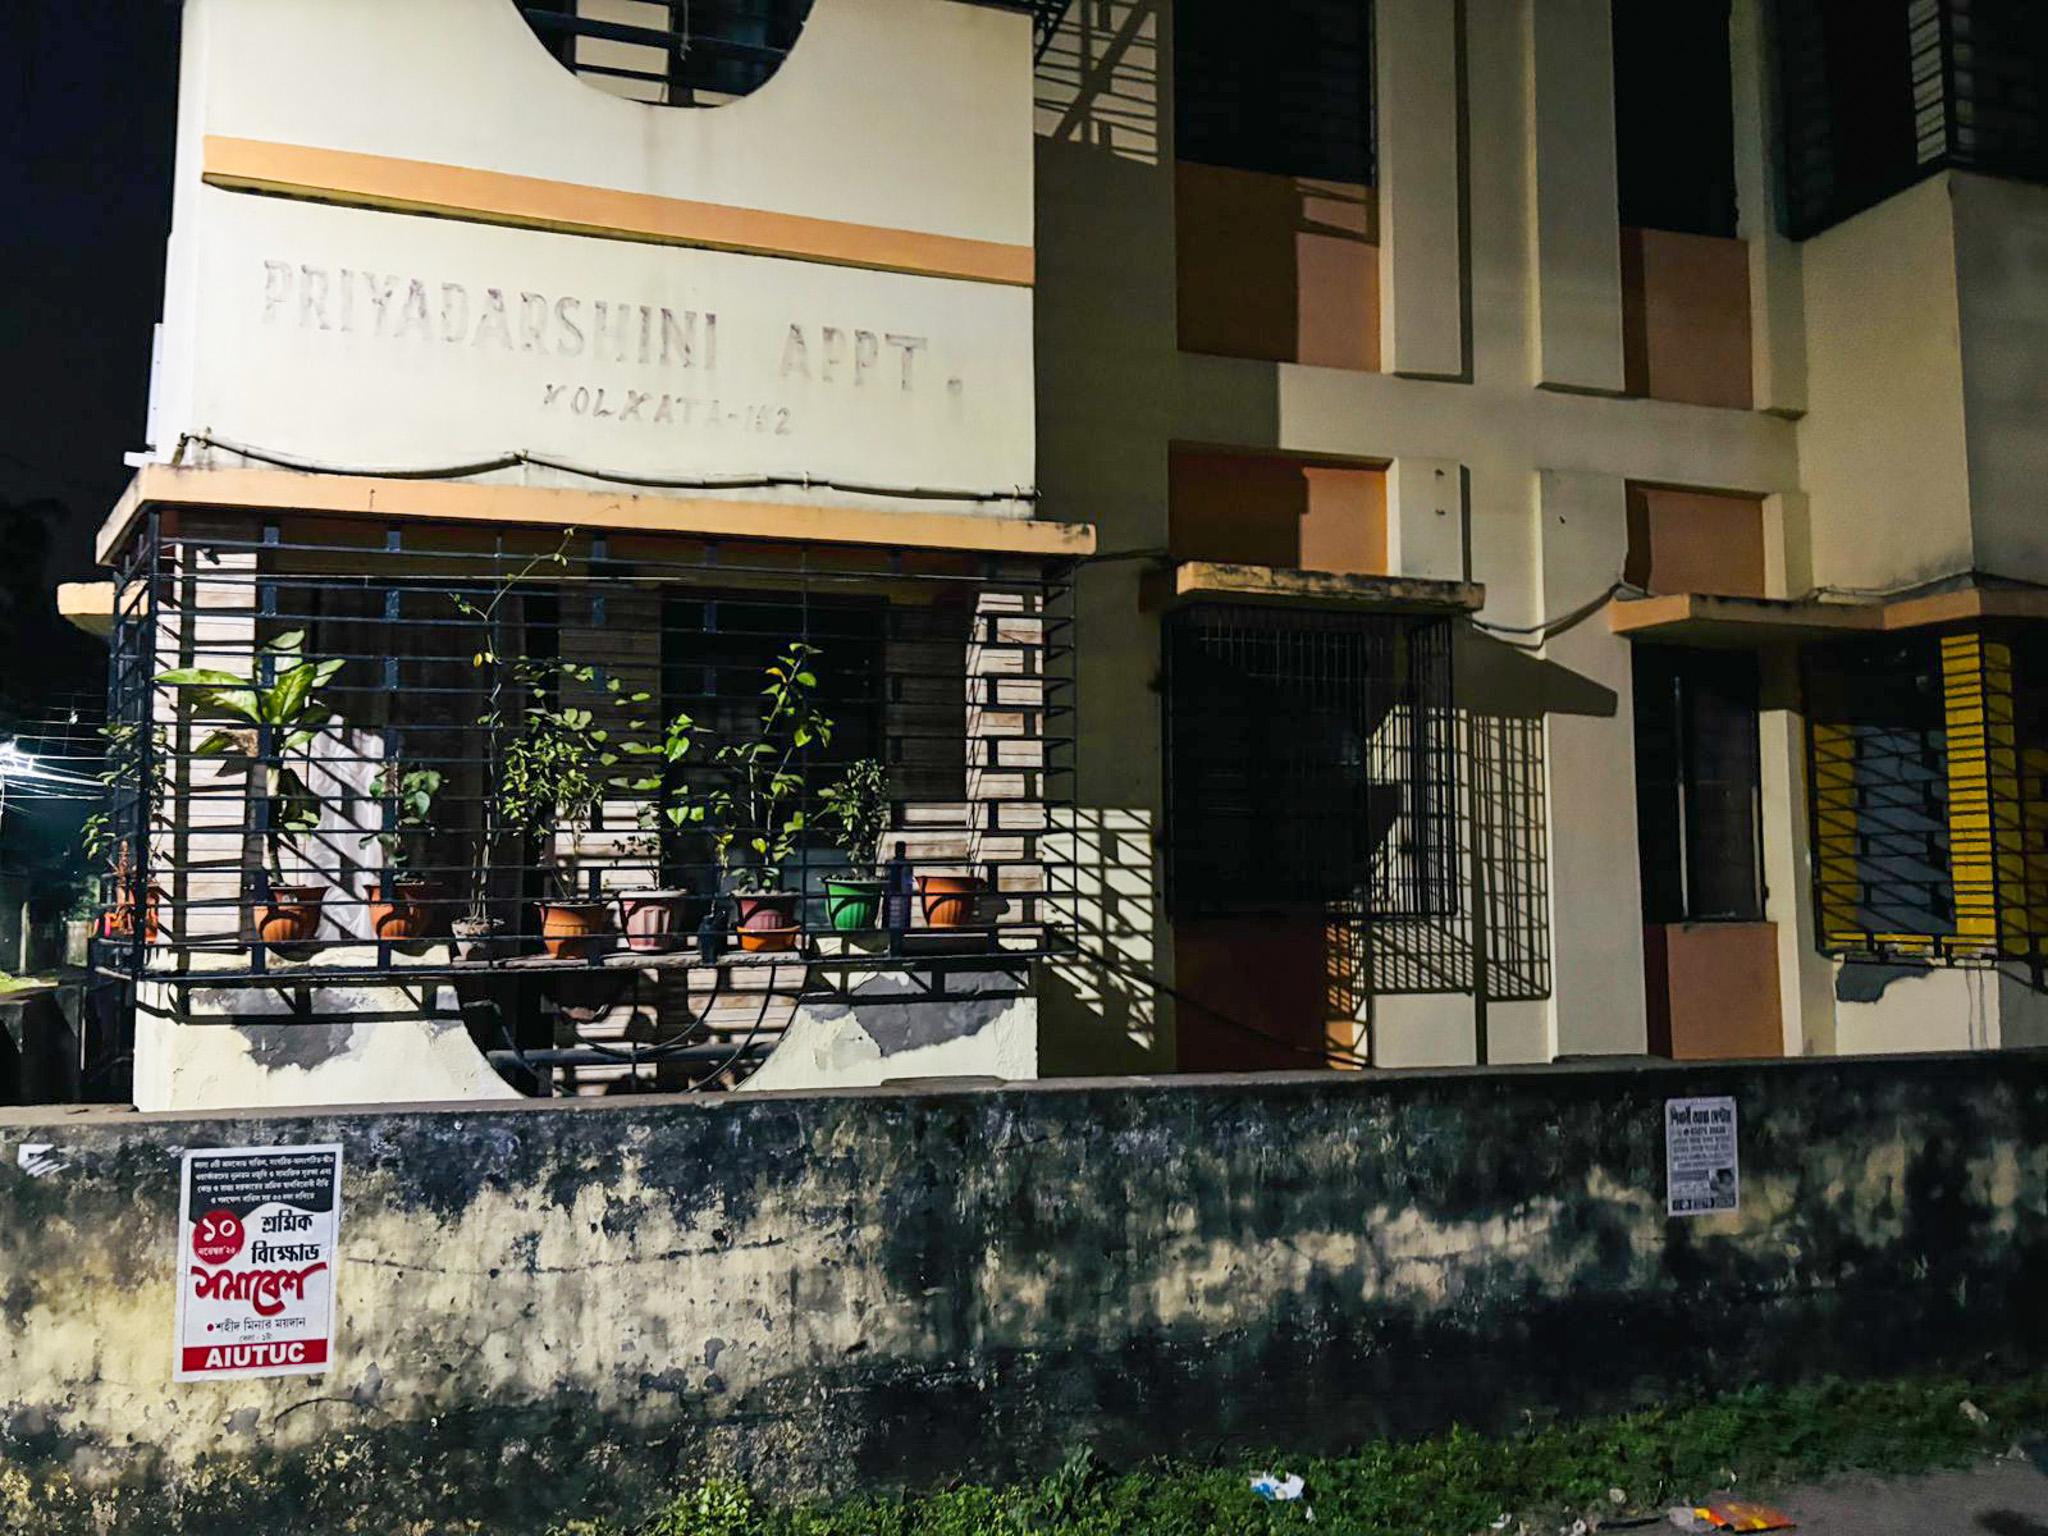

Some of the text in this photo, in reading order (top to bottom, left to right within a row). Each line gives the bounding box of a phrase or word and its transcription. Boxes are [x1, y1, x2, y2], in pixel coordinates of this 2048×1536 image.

[261, 257, 718, 371] PRIYADARSHINI
[202, 1218, 236, 1242] ১০
[261, 1209, 314, 1233] শ্রমিক
[191, 1262, 328, 1316] সমাবেশ
[215, 1317, 306, 1333] শহীদ মিনার ময়দান
[204, 1342, 305, 1368] AIUTUC
